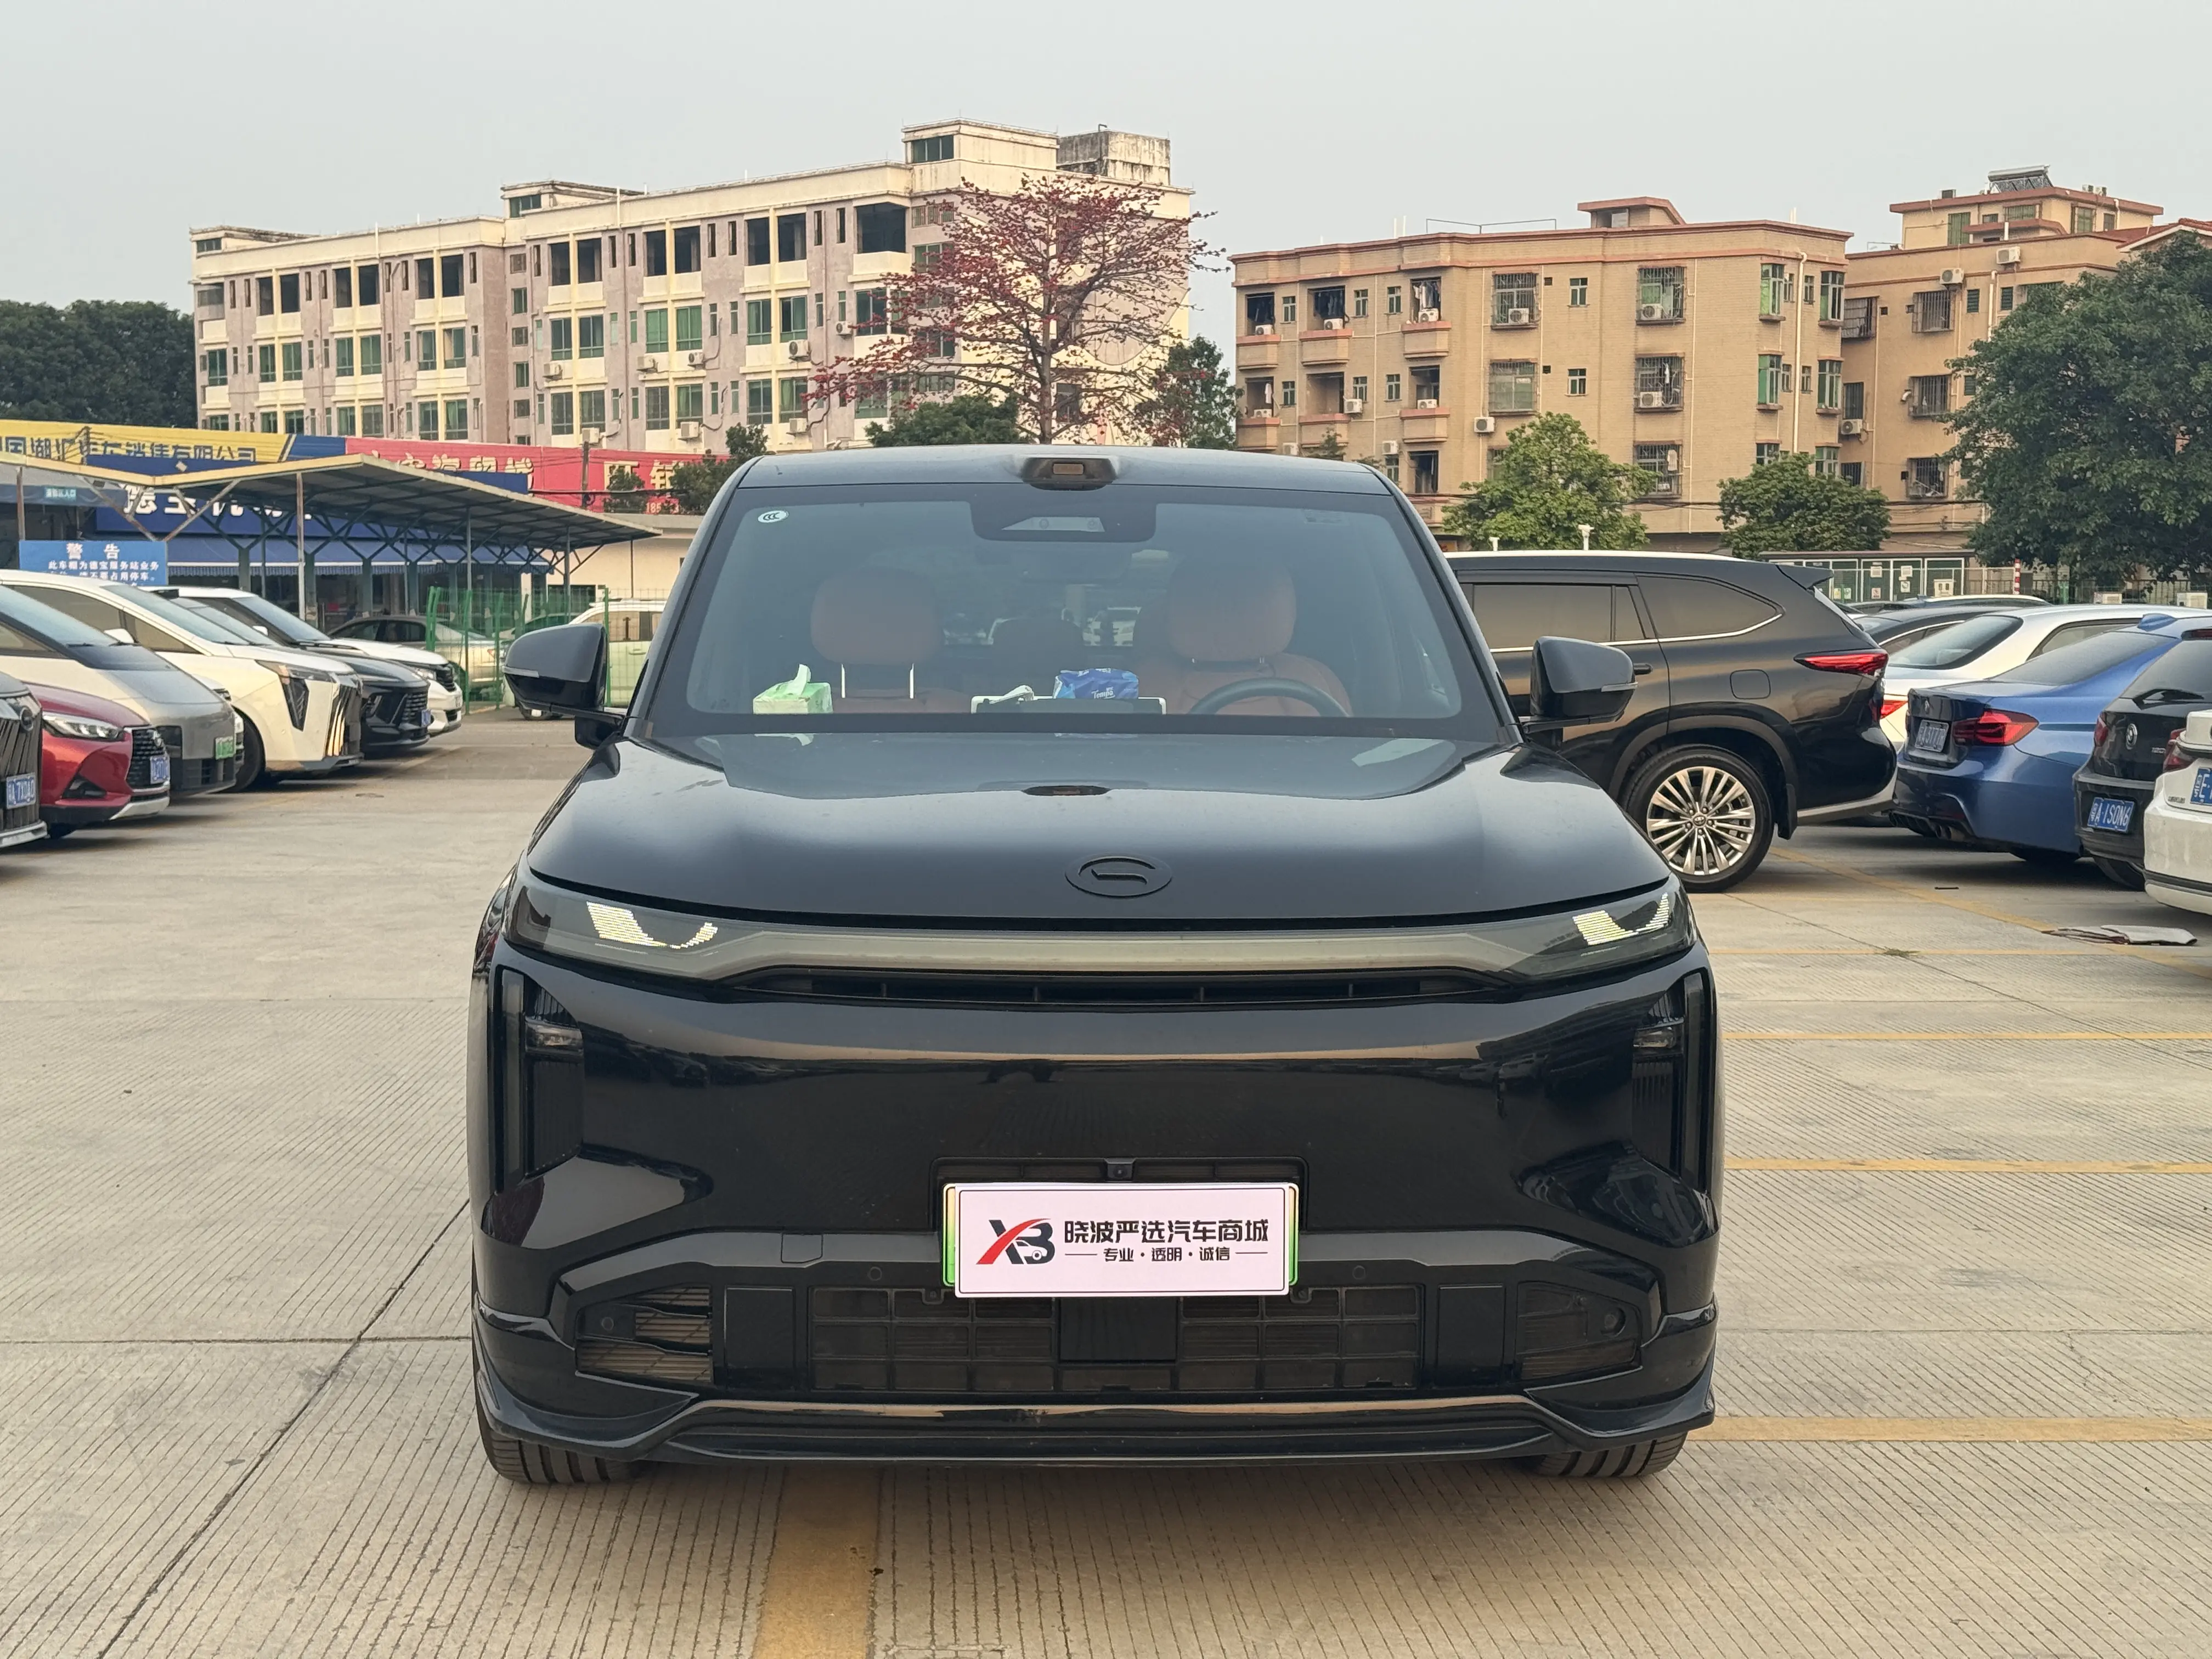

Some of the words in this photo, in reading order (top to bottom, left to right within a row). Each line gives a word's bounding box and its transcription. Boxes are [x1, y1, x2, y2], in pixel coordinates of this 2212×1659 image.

[1064, 1219, 1269, 1244] 晓波严选汽车商城
